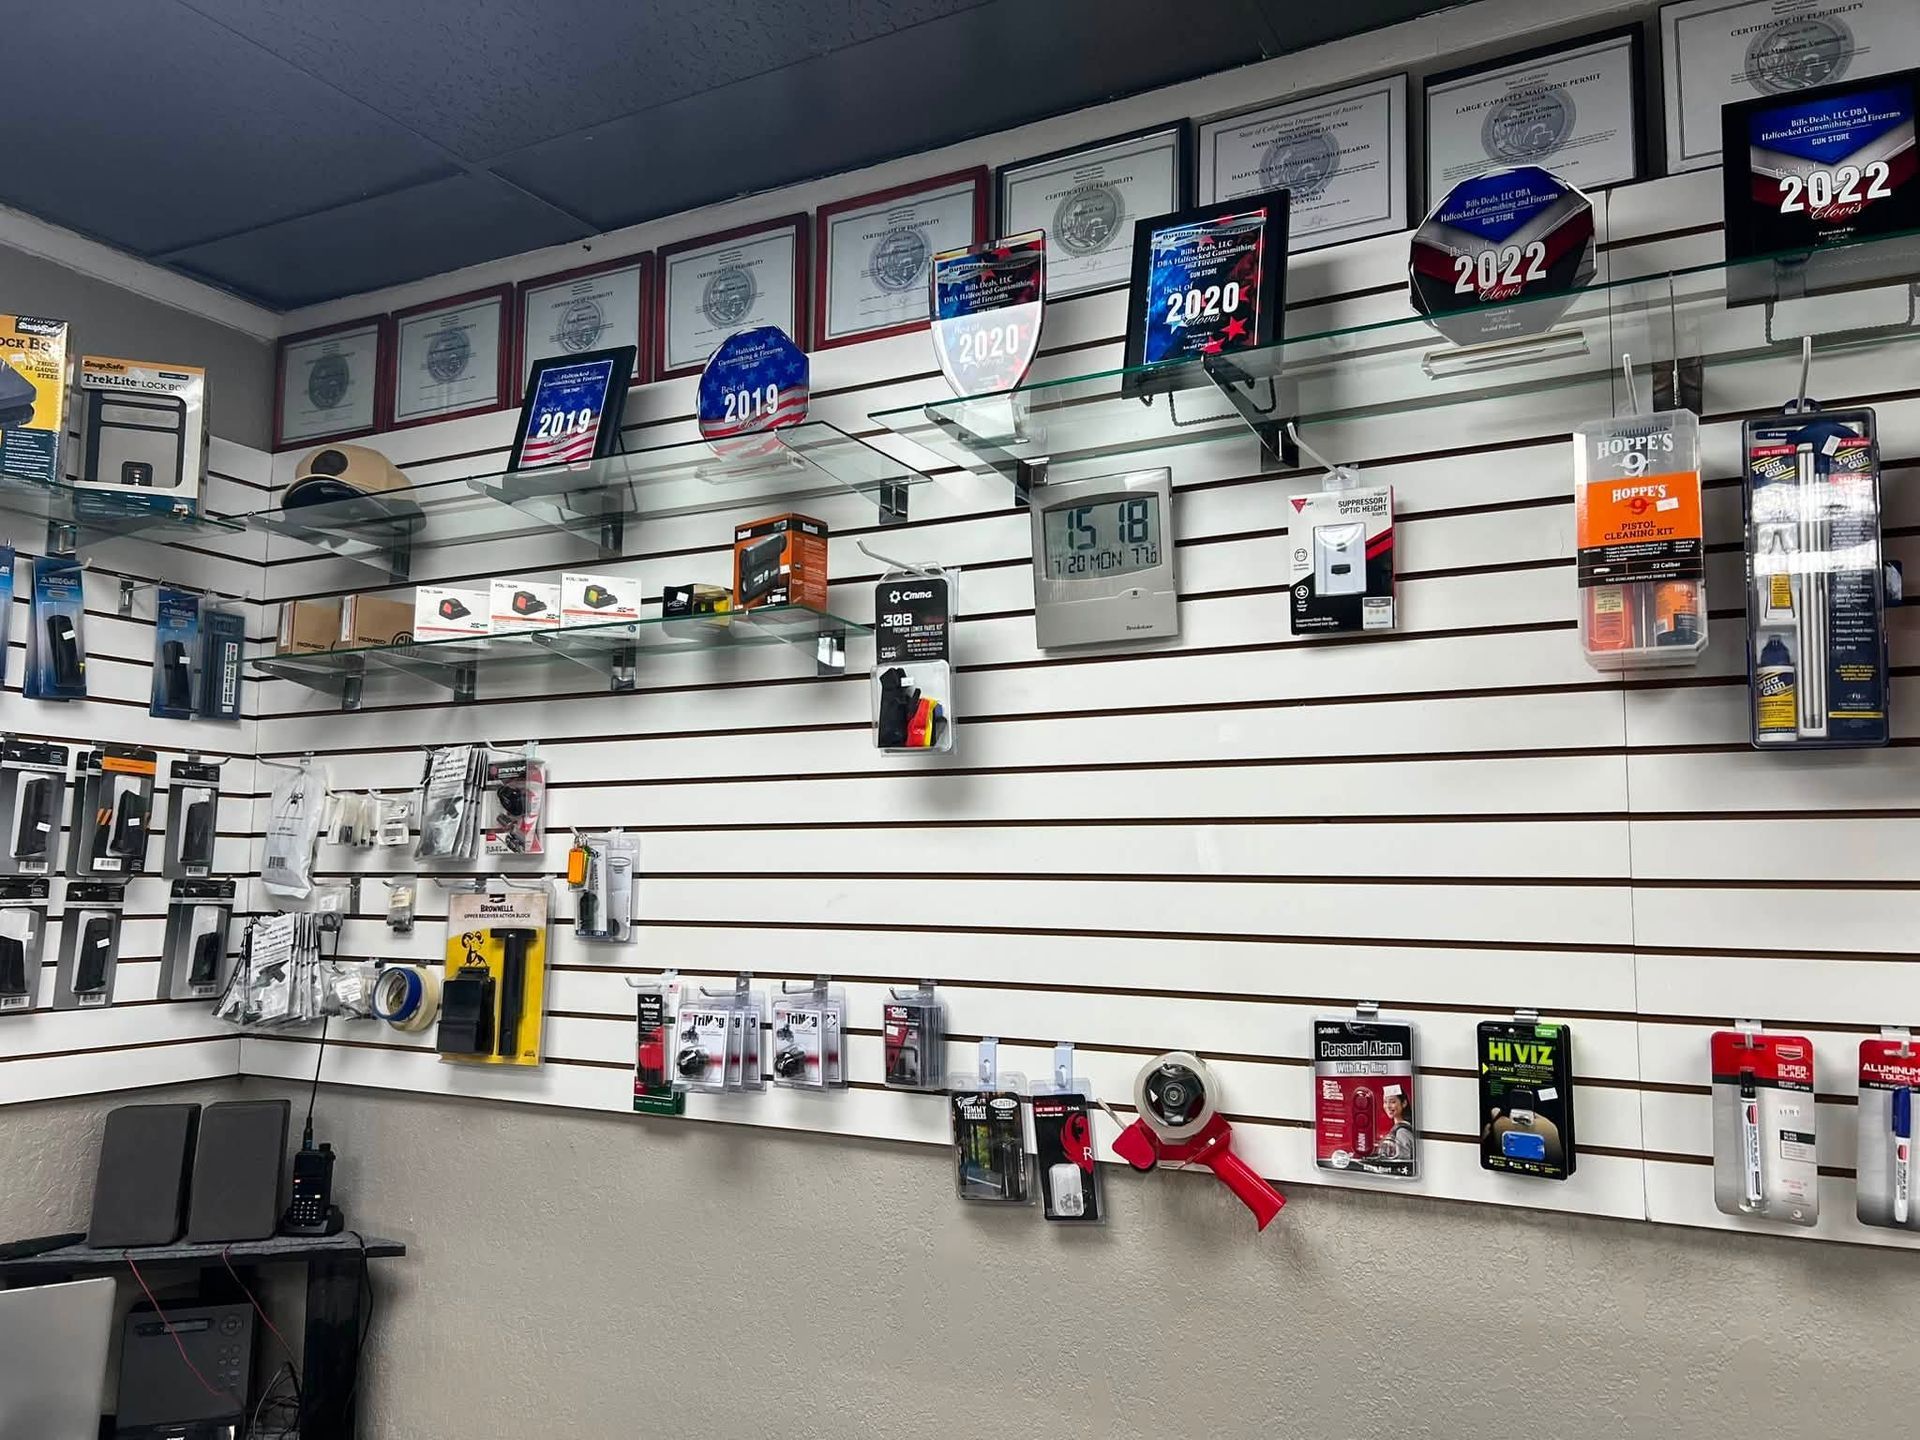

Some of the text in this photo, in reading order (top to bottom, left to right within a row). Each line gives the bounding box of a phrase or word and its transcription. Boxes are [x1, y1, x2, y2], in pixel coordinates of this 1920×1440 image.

[1730, 19, 1791, 37] CERTIFICATE
[1455, 73, 1601, 115] LARGE CAPACITY MAGAZINE PERMIT
[1791, 119, 1808, 127] Bills
[1833, 110, 1849, 119] LLC
[1850, 107, 1868, 117] DBA
[1762, 111, 1900, 141] Halfcocked Gunsmithing and Firearms
[1828, 133, 1850, 143] STORE
[1779, 161, 1891, 213] 2022
[1501, 192, 1514, 200] LLC
[1441, 193, 1558, 222] Halfcocked Gunsmithing and Firearms
[1810, 202, 1861, 220] Clovis
[1219, 240, 1233, 248] LLC
[1174, 253, 1210, 265] Halfcocked
[1212, 243, 1256, 257] Gunsmithing
[1454, 241, 1546, 294] 2022
[1000, 275, 1013, 284] LLC
[960, 289, 993, 300] Halfcocked
[994, 280, 1035, 293] Gunsmithing
[1479, 284, 1521, 301] Clovis
[969, 293, 1008, 307] and Firearms
[1166, 281, 1240, 323] 2020
[960, 324, 1018, 363] 2020
[84, 360, 124, 370] SnapSafe
[84, 373, 137, 387] TrekLite
[141, 381, 167, 390] LOCK
[721, 382, 745, 394] Best of
[724, 383, 778, 423] 2019
[537, 408, 591, 438] 2019
[1597, 433, 1673, 460] HOPPE'S
[1622, 452, 1646, 477] 9
[1764, 463, 1787, 478] Gun
[1848, 456, 1870, 470] Gun
[1612, 484, 1666, 503] HOPPE'S
[1340, 504, 1387, 515] OPTIC HEIGHT
[1630, 497, 1648, 515] 9
[1068, 500, 1148, 550] 15 18
[1622, 520, 1656, 531] PISTOL
[1604, 527, 1674, 541] CLEANING KIT
[1068, 555, 1085, 573] 20
[1090, 551, 1122, 570] MON
[881, 613, 912, 627] .308
[1763, 681, 1785, 696] Gun
[480, 904, 513, 912] BROWNELLS
[693, 1015, 724, 1028] TriMg
[786, 1013, 817, 1028] TriMg
[1321, 1040, 1403, 1057] Personal Alarm
[1489, 1042, 1553, 1066] HI VIZ
[1336, 1061, 1388, 1074] With Key Ring
[1777, 1064, 1807, 1073] SUPER
[1778, 1070, 1806, 1079] BLACK
[1863, 1063, 1920, 1075] ALUMINUM
[964, 1106, 986, 1115] TOMMY
[1083, 1147, 1093, 1160] R
